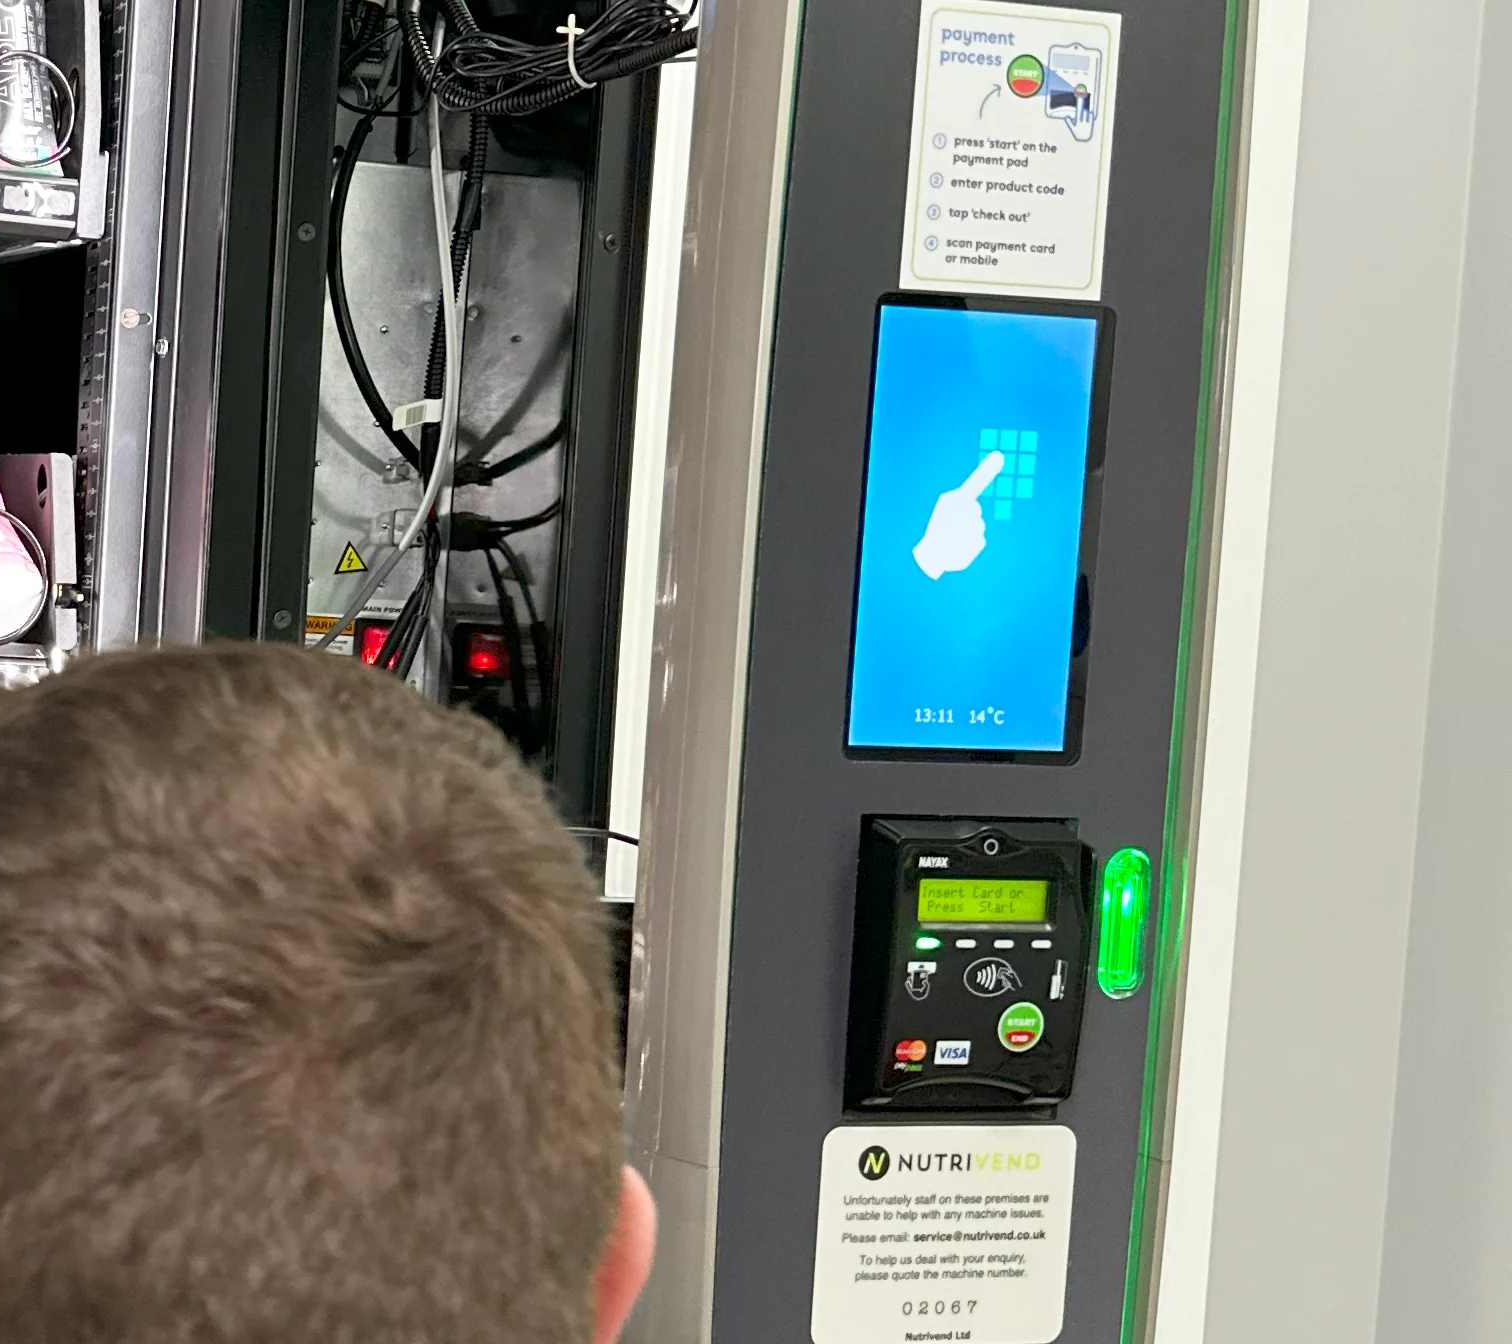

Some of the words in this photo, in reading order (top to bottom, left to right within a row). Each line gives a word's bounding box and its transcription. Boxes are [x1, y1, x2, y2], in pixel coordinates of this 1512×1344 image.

[941, 27, 1015, 46] payment
[939, 48, 1002, 66] process
[954, 137, 984, 149] press
[1023, 143, 1036, 152] on
[1039, 142, 1057, 153] the
[952, 153, 1003, 167] payment
[1007, 156, 1029, 169] pad
[951, 178, 983, 189] enter
[986, 180, 1033, 194] product
[1036, 184, 1065, 196] code
[949, 209, 968, 221] tap
[946, 238, 972, 249] scan
[975, 239, 1026, 254] payment
[1030, 242, 1055, 254] card
[945, 254, 957, 264] or
[959, 255, 998, 266] mobile
[914, 708, 954, 724] 13:11
[969, 706, 1005, 725] 14°C
[918, 856, 949, 869] NAYAX
[922, 886, 965, 898] Insert
[973, 886, 1002, 898] Card
[1009, 888, 1024, 898] or
[939, 1046, 967, 1059] VISA
[898, 1152, 1042, 1172] NUTRIVEND
[844, 1194, 911, 1206] Unfortunately
[914, 1193, 936, 1205] staff
[939, 1196, 951, 1204] on
[955, 1194, 981, 1204] these
[984, 1194, 1030, 1206] premises
[1033, 1194, 1049, 1203] are
[845, 1210, 880, 1220] unable
[883, 1210, 893, 1220] to
[896, 1209, 918, 1221] help
[920, 1209, 940, 1219] with
[944, 1211, 962, 1221] any
[964, 1208, 1007, 1219] machine
[841, 1232, 876, 1243] Please
[879, 1232, 910, 1243] email:
[913, 1230, 1045, 1243] service@nutrivend.co.uk
[859, 1254, 872, 1265] To
[875, 1254, 897, 1267] help
[900, 1256, 912, 1265] us
[915, 1254, 936, 1264] deal
[939, 1253, 960, 1264] with
[962, 1255, 985, 1266] your
[854, 1271, 889, 1283] please
[891, 1270, 920, 1282] quote
[923, 1269, 939, 1280] the
[942, 1268, 984, 1279] machine
[905, 1332, 953, 1342] Nutrivend
[955, 1331, 971, 1340] Ltd
